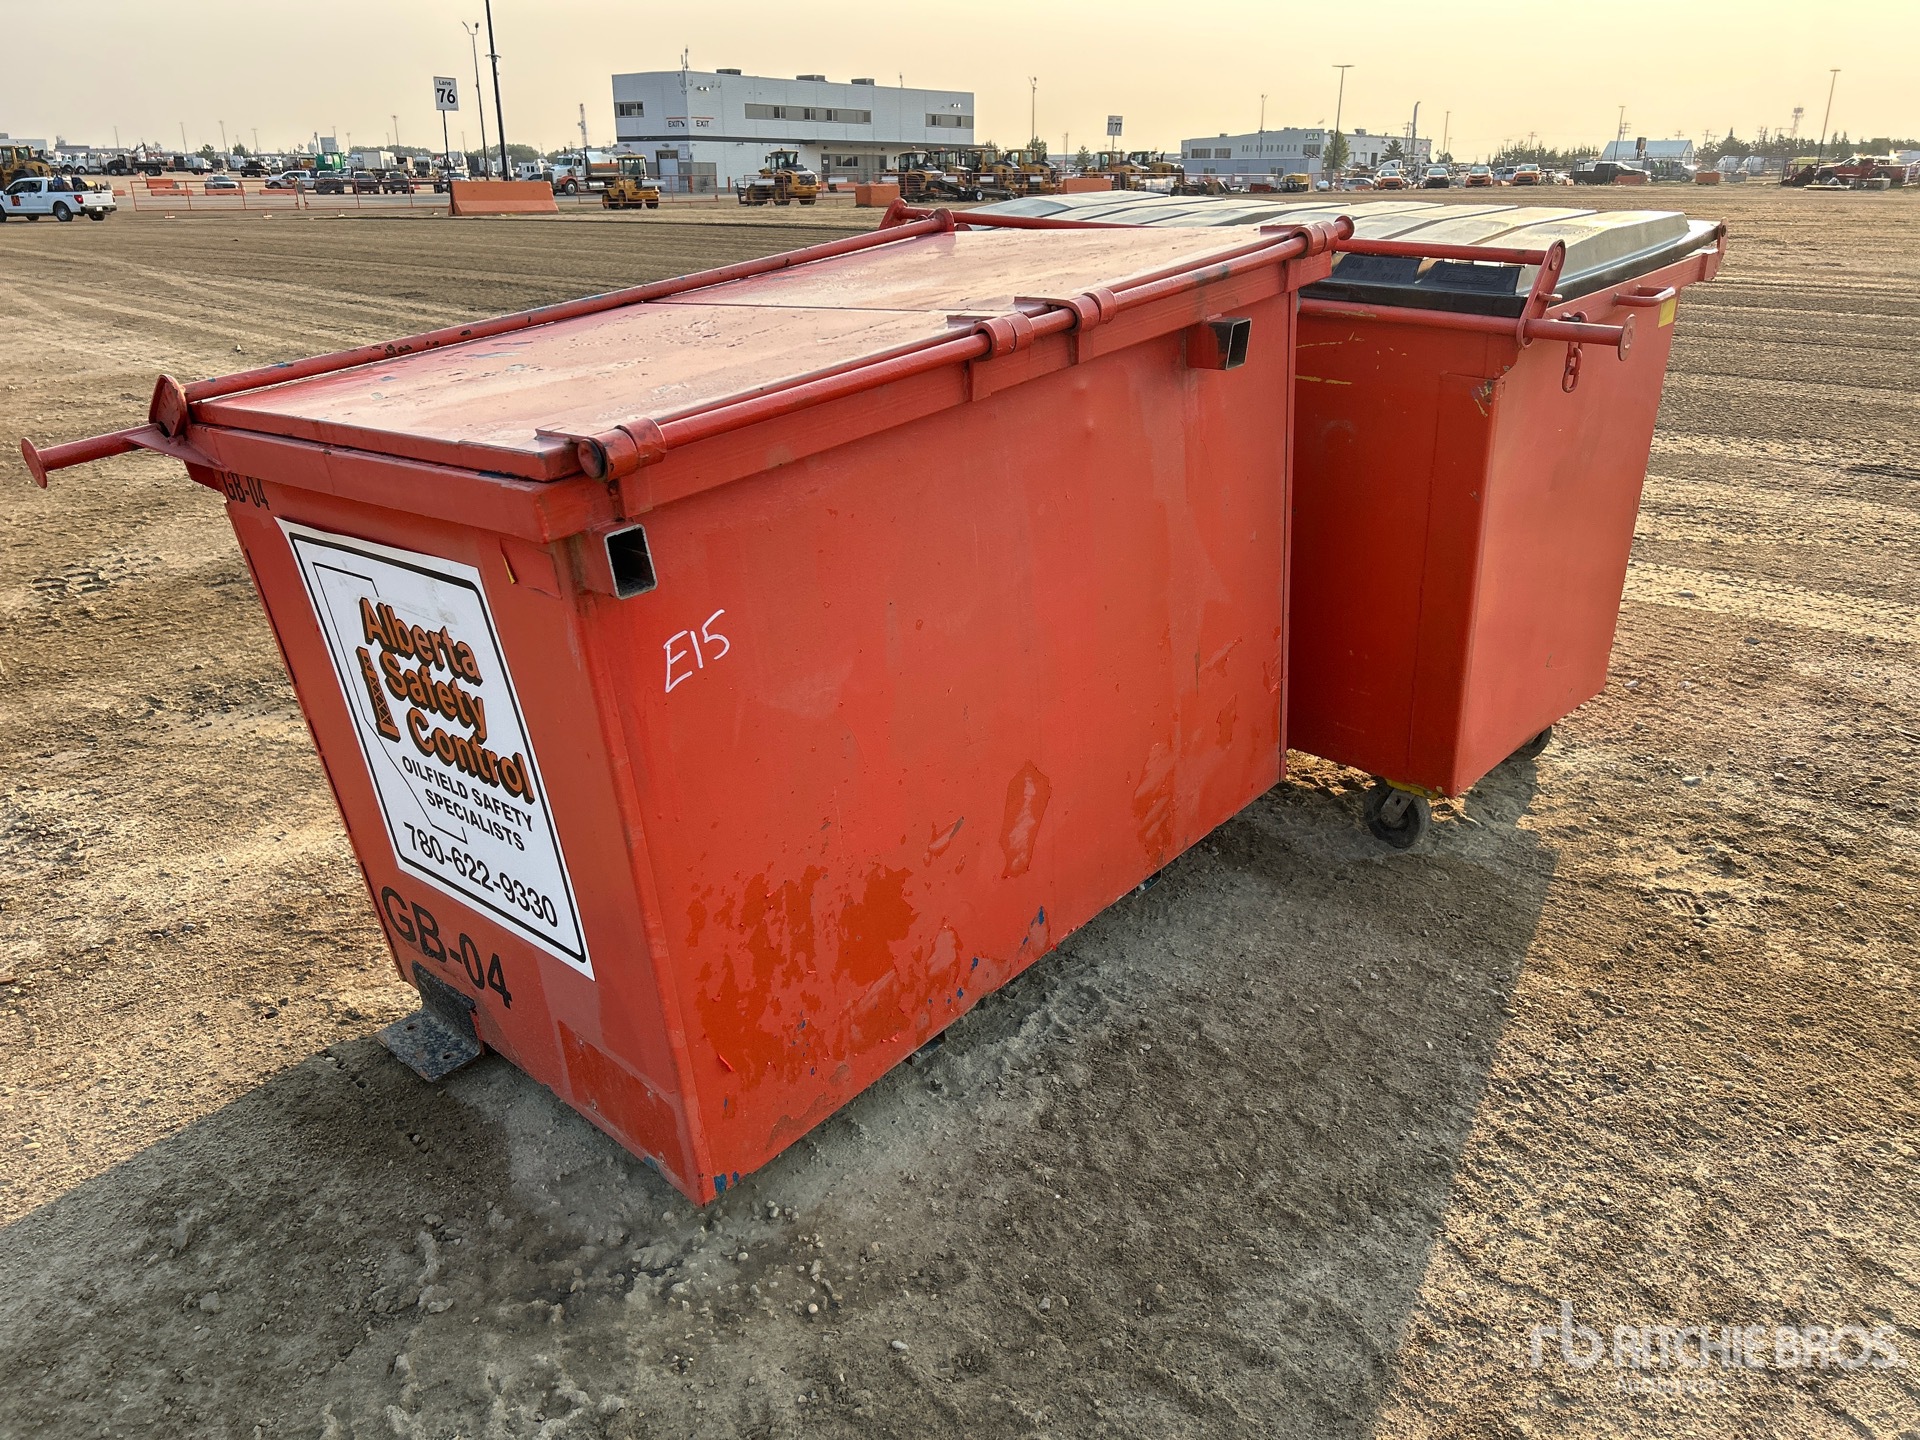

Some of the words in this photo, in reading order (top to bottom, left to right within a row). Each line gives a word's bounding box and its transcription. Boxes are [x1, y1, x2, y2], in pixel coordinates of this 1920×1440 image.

[436, 88, 456, 104] 76
[667, 120, 680, 128] EXIT
[695, 120, 710, 128] EXIT
[359, 597, 483, 687] Alberta
[378, 650, 488, 745] Safety
[402, 755, 469, 800] OILFIELD
[471, 787, 533, 832] SAFETY
[406, 706, 536, 805] Control
[424, 788, 525, 852] SPECIALISTS
[403, 821, 558, 928] 780-622-9330
[381, 886, 513, 1010] GB-04
